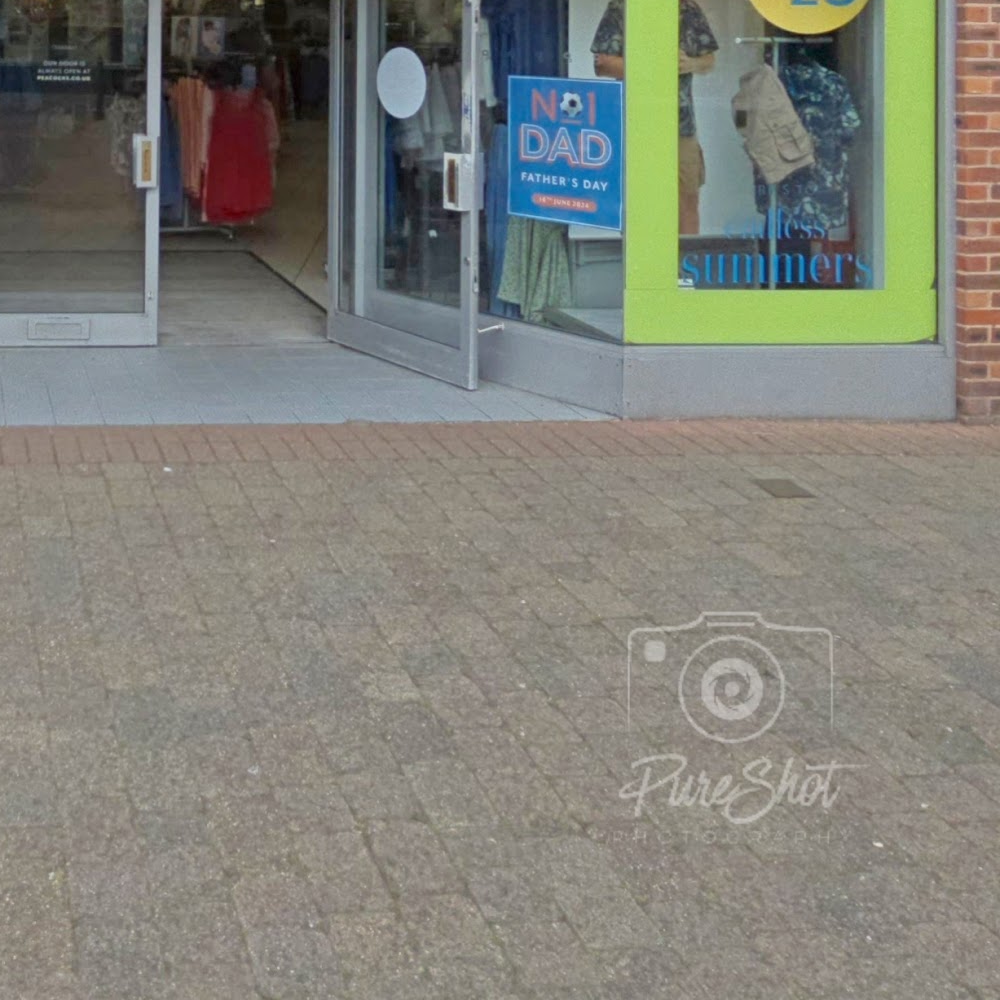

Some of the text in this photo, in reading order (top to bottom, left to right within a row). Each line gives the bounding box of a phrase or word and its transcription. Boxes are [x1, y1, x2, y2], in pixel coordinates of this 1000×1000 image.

[520, 123, 612, 169] DAD
[520, 171, 609, 192] FATHER'S DAY
[680, 251, 876, 287] summers
